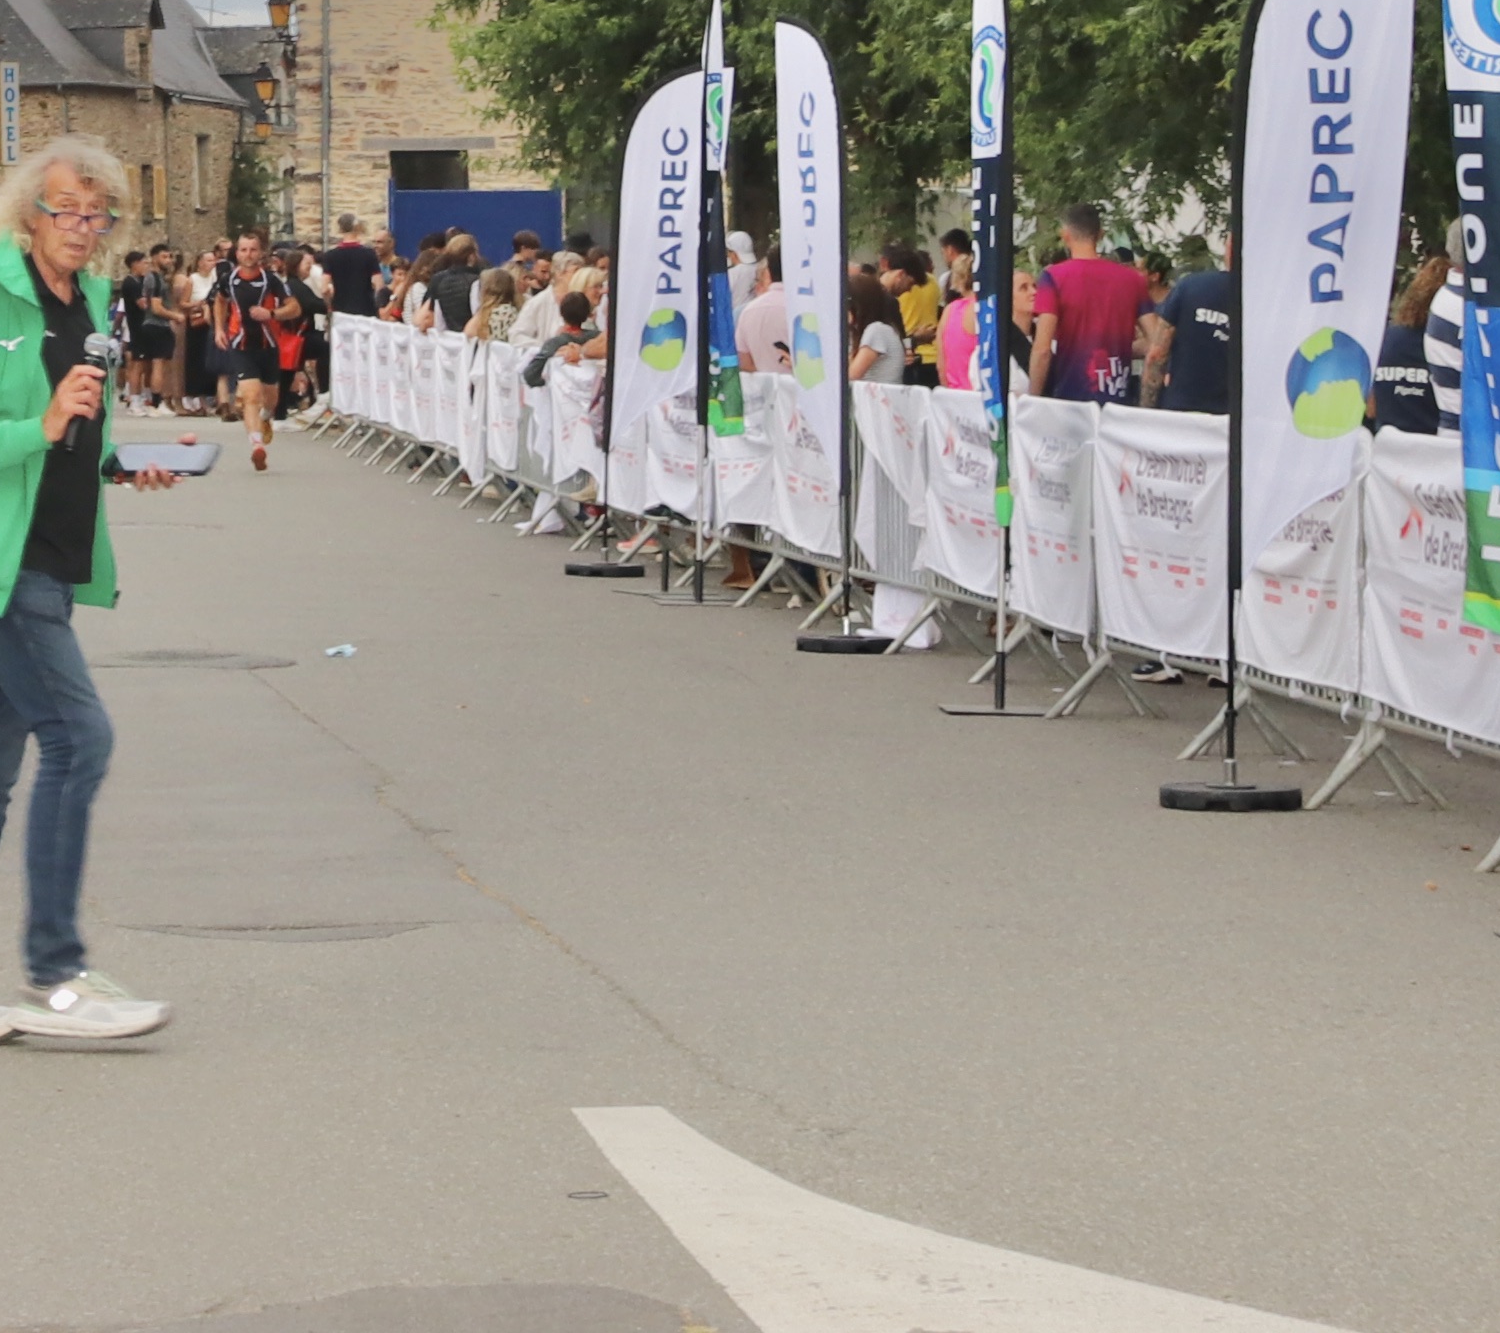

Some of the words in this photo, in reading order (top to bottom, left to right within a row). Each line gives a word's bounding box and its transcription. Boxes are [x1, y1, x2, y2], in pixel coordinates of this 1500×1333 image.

[3, 67, 16, 162] HOTEL
[1306, 8, 1355, 304] PAPREC
[656, 127, 689, 295] PAPREC
[1195, 307, 1230, 328] SUP
[1375, 366, 1429, 384] SUPER
[1441, 530, 1466, 572] Bret
